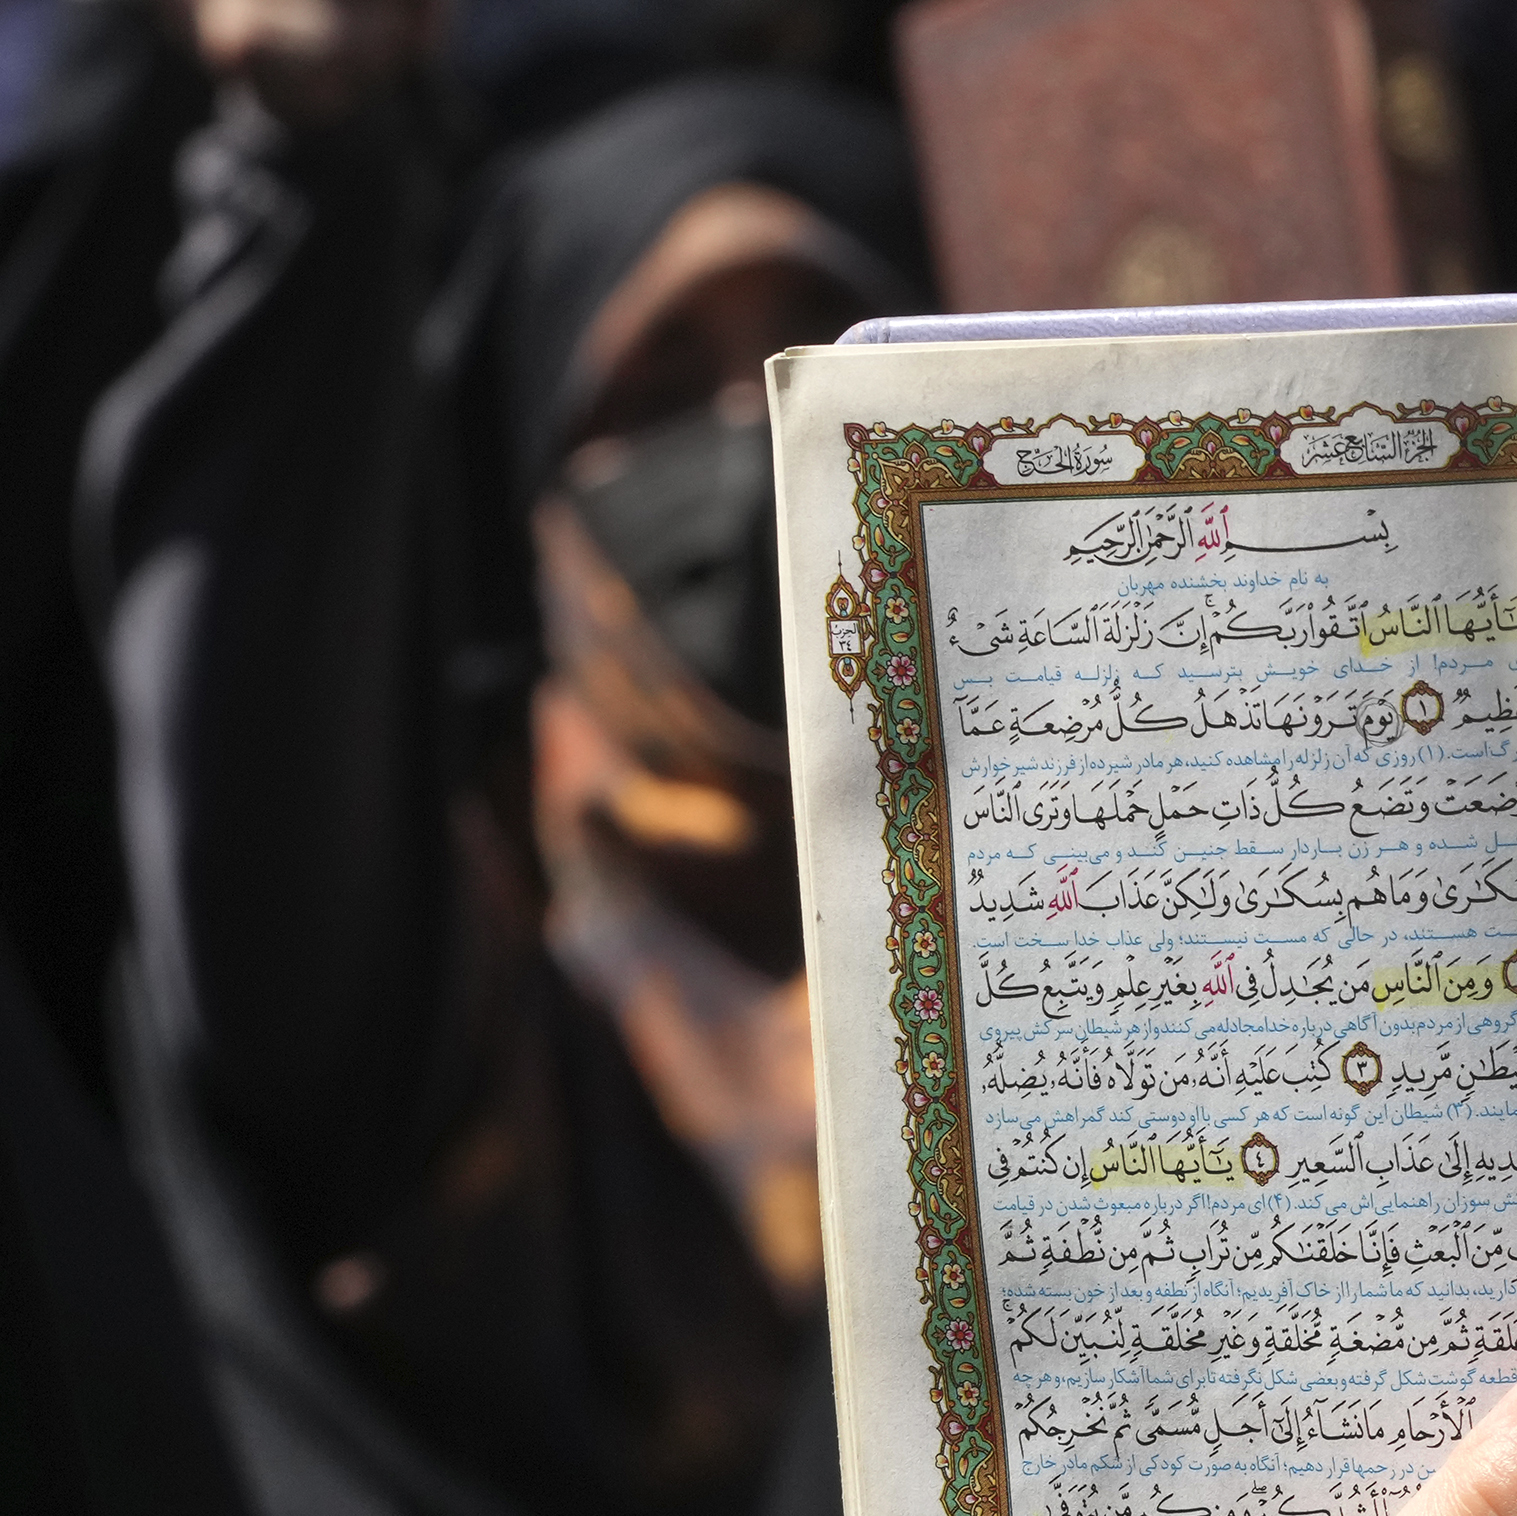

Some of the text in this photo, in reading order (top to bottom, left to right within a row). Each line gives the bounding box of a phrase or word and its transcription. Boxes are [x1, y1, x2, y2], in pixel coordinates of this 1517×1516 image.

[1117, 570, 1329, 597] به نام خداوند بخشنده مهربان
[1133, 663, 1164, 680] که
[1178, 663, 1243, 681] بترسید
[1255, 663, 1319, 683] خویش
[1333, 657, 1393, 680] خدای
[1410, 655, 1420, 677] از
[953, 676, 993, 691] بس
[1005, 666, 1062, 686] قیامت
[1075, 665, 1120, 687] زلزله
[1226, 747, 1284, 772] مشاهده
[1283, 749, 1296, 771] را
[1296, 750, 1331, 770] زلزله
[1334, 745, 1353, 769] آن
[1353, 746, 1373, 764] که
[1375, 751, 1416, 769] روزی
[1137, 754, 1165, 775] مادر
[1168, 757, 1185, 774] هر
[1006, 842, 1037, 859] که
[1127, 841, 1168, 859] کند
[1234, 838, 1285, 856] سقط
[1291, 838, 1343, 861] باردار
[1348, 839, 1370, 859] زن
[1378, 838, 1410, 858] هر
[1416, 842, 1423, 857] و
[1430, 834, 1479, 849] شده
[967, 851, 1002, 867] مردم
[1116, 850, 1123, 863] و
[1173, 845, 1228, 863] جنین
[1014, 933, 1070, 948] سخت
[1074, 931, 1100, 948] خدا
[1105, 932, 1143, 948] عذاب
[1148, 930, 1174, 951] ولی
[1253, 932, 1308, 945] مست
[1313, 926, 1332, 943] که
[1337, 926, 1375, 949] حالی
[1382, 930, 1398, 948] در
